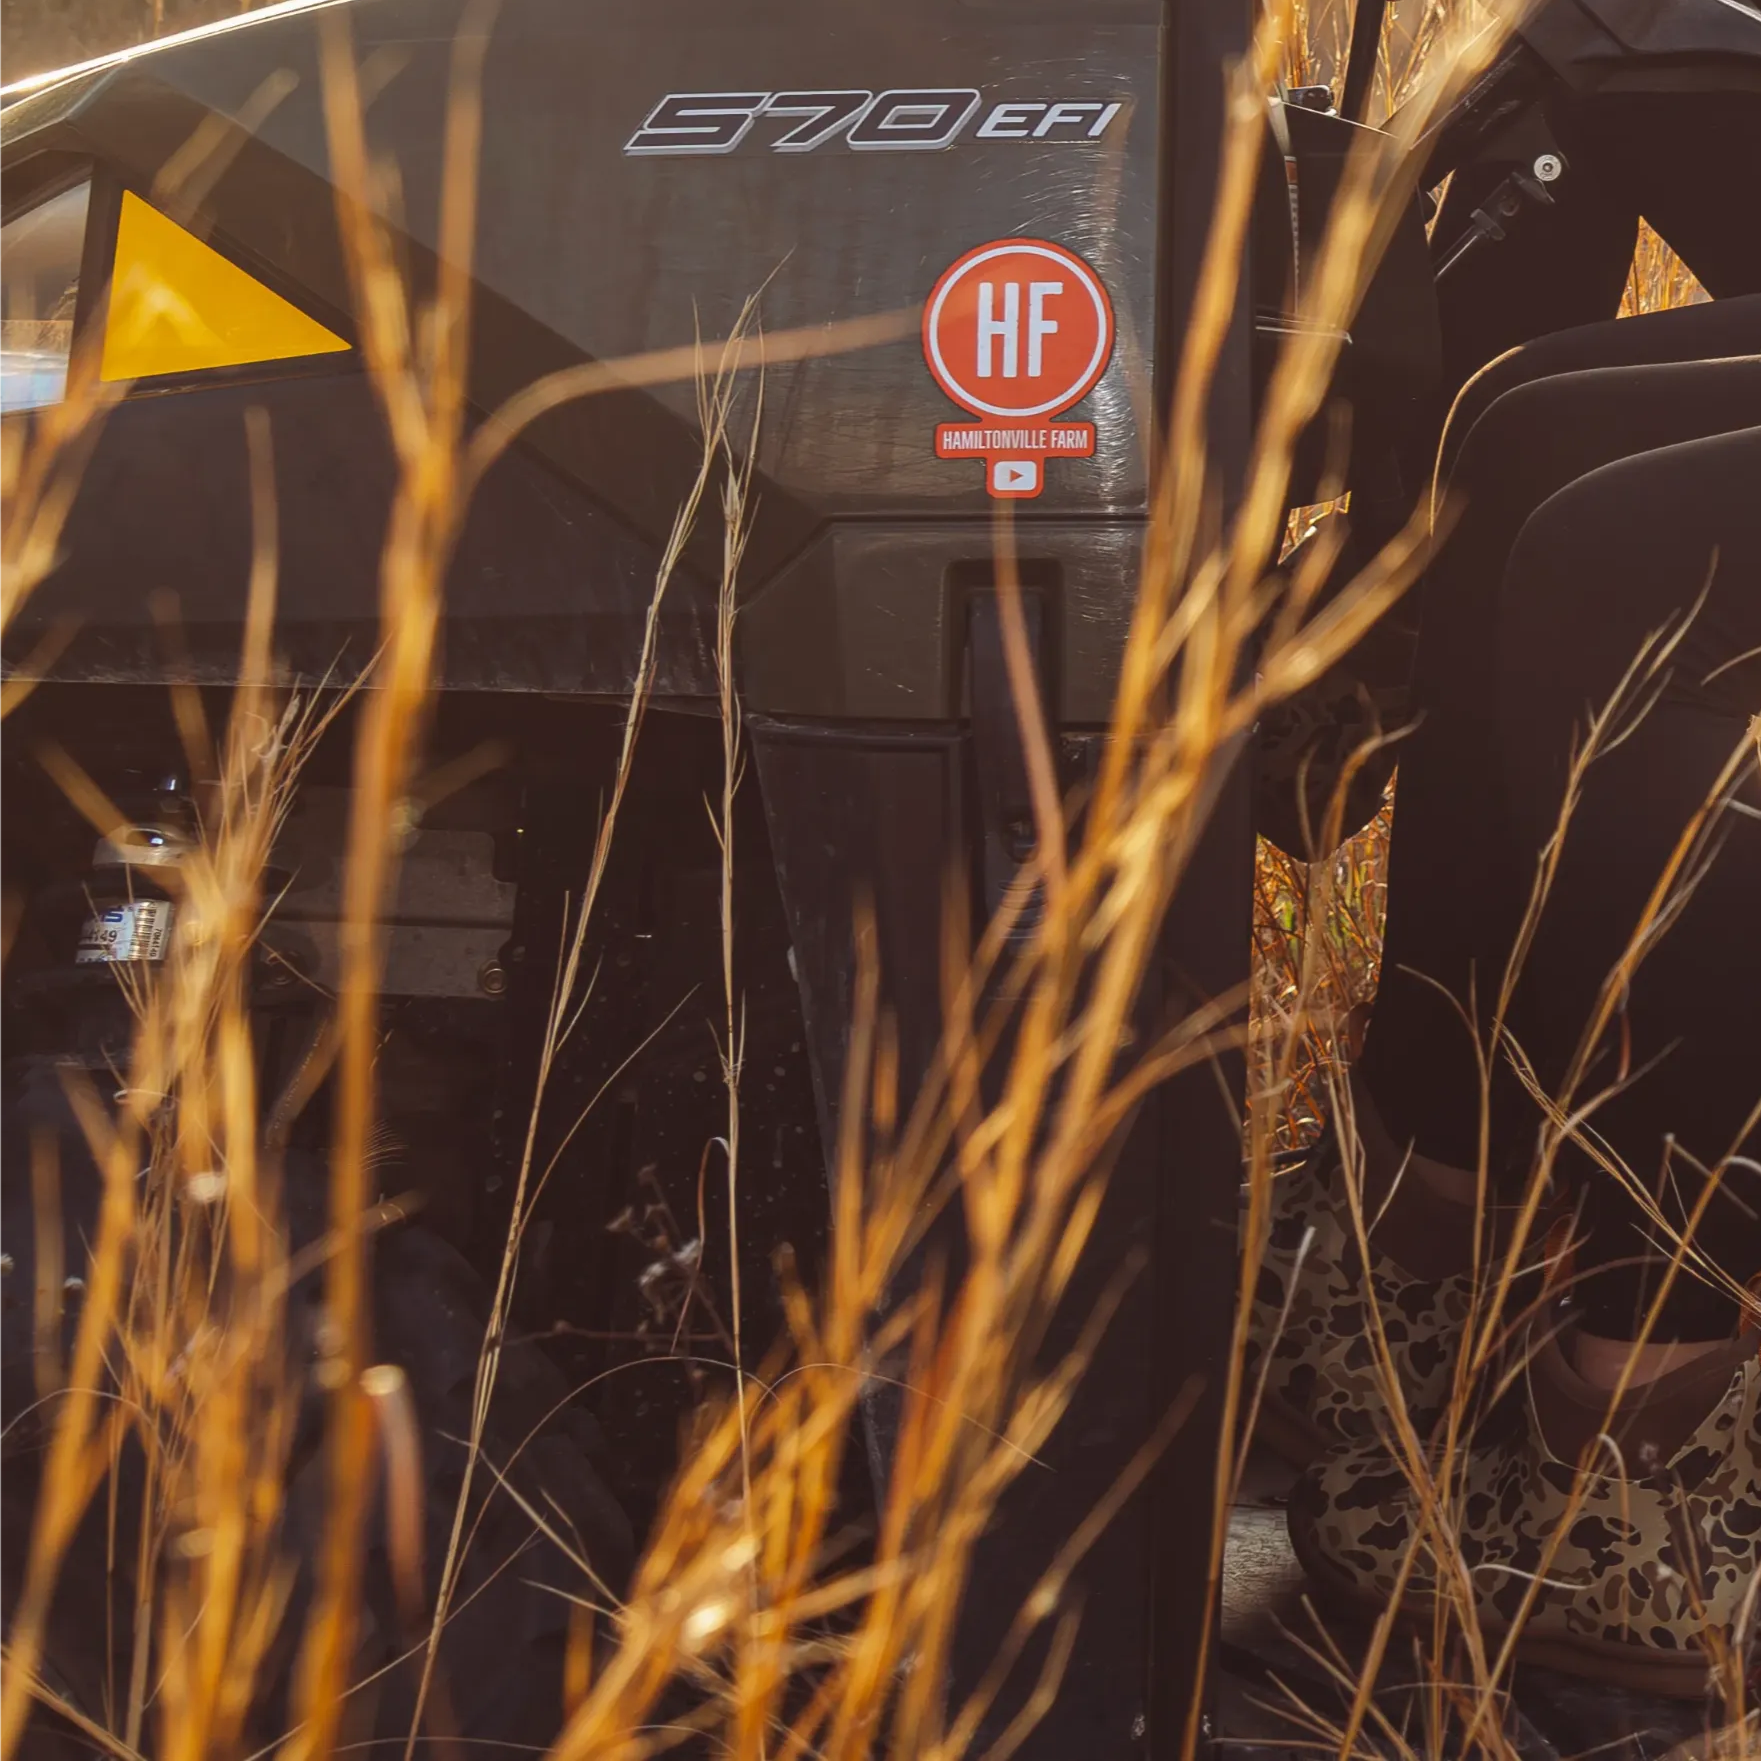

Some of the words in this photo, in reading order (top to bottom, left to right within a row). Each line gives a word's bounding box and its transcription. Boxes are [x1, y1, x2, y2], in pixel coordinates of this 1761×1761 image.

[623, 89, 982, 155] 570
[975, 103, 1122, 137] EFI
[977, 281, 1063, 378] HF
[943, 430, 1047, 449] HAMILTONVILLE
[1051, 430, 1088, 449] FARM
